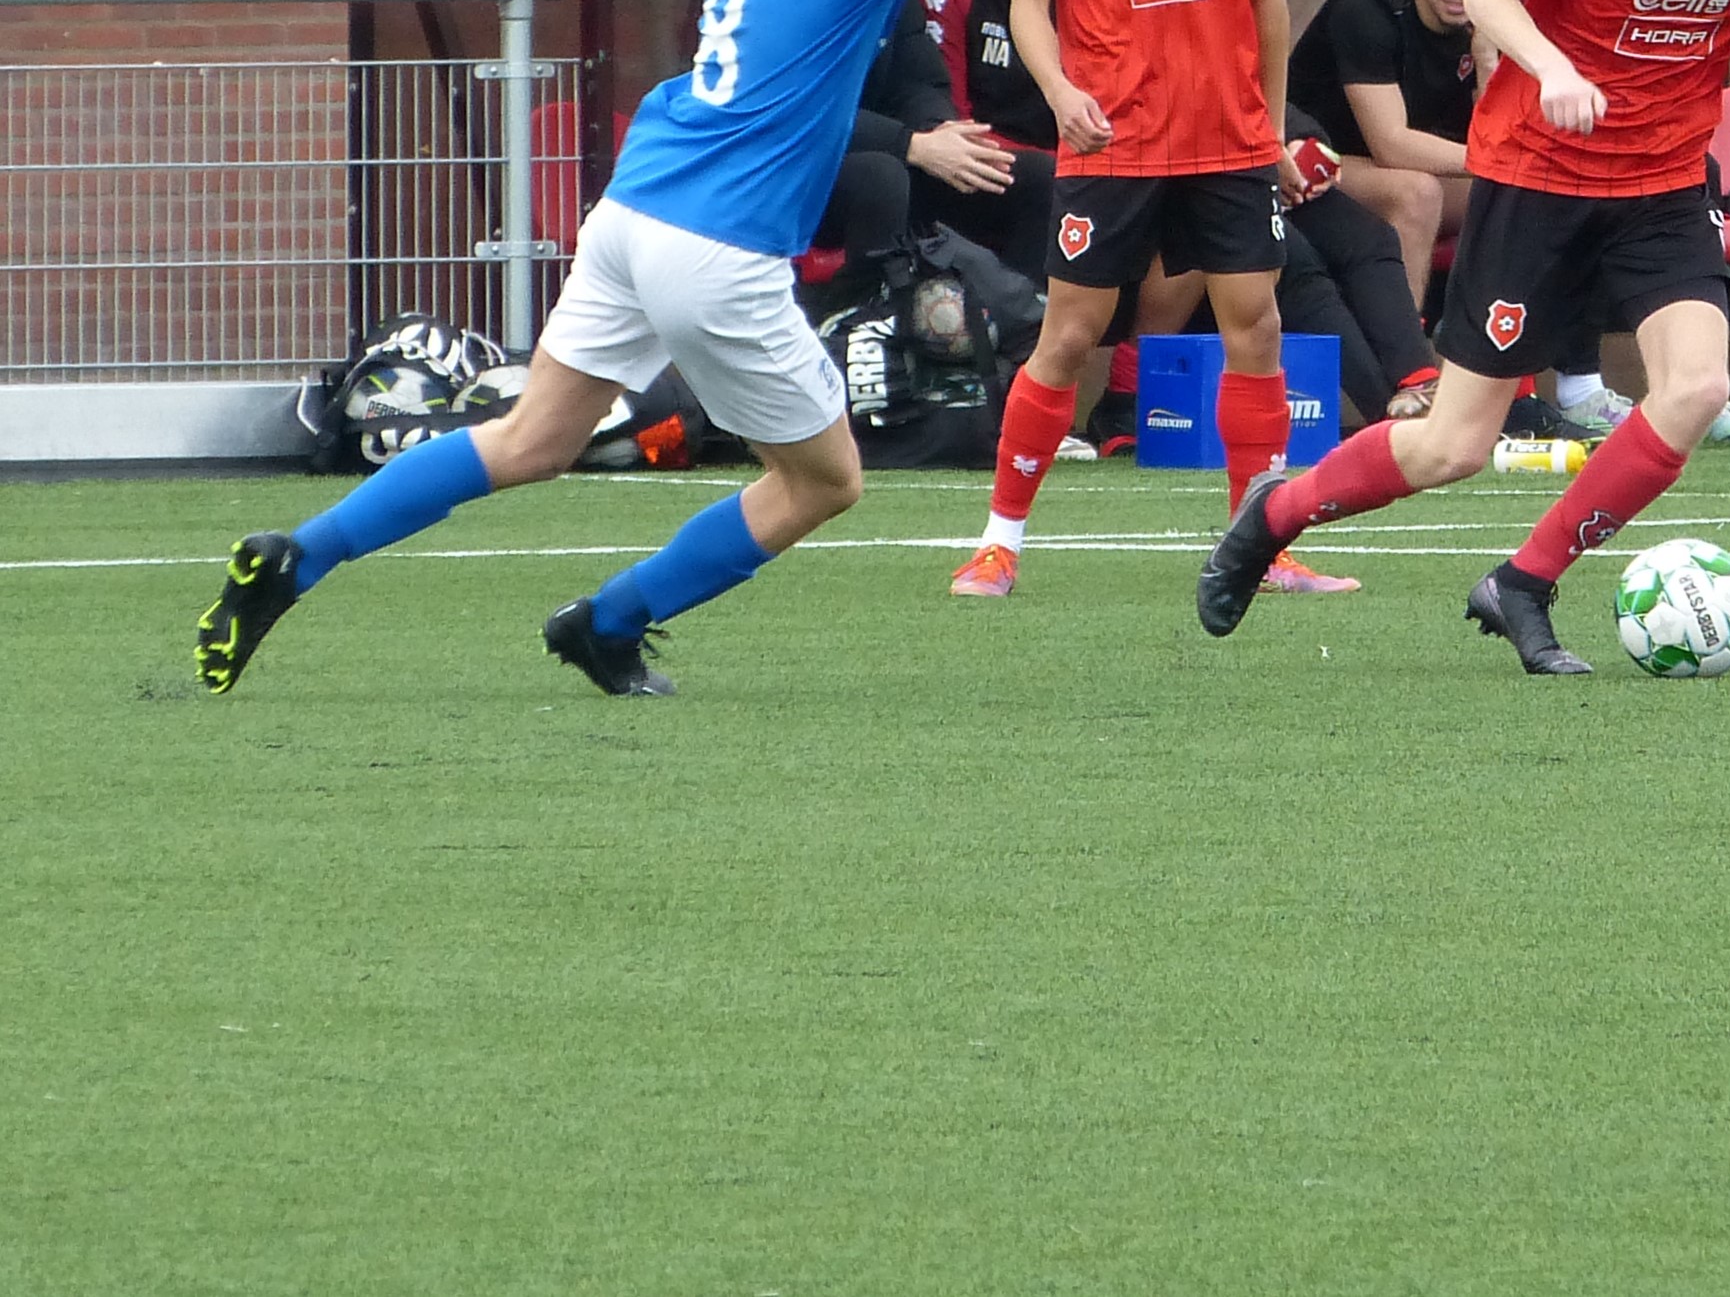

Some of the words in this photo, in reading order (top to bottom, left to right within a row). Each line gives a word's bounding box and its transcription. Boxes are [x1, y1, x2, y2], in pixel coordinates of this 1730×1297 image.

[1630, 27, 1708, 45] HORA
[982, 37, 1010, 68] NA
[1147, 417, 1193, 429] maxim
[1679, 574, 1720, 648] DERBYSTAR
